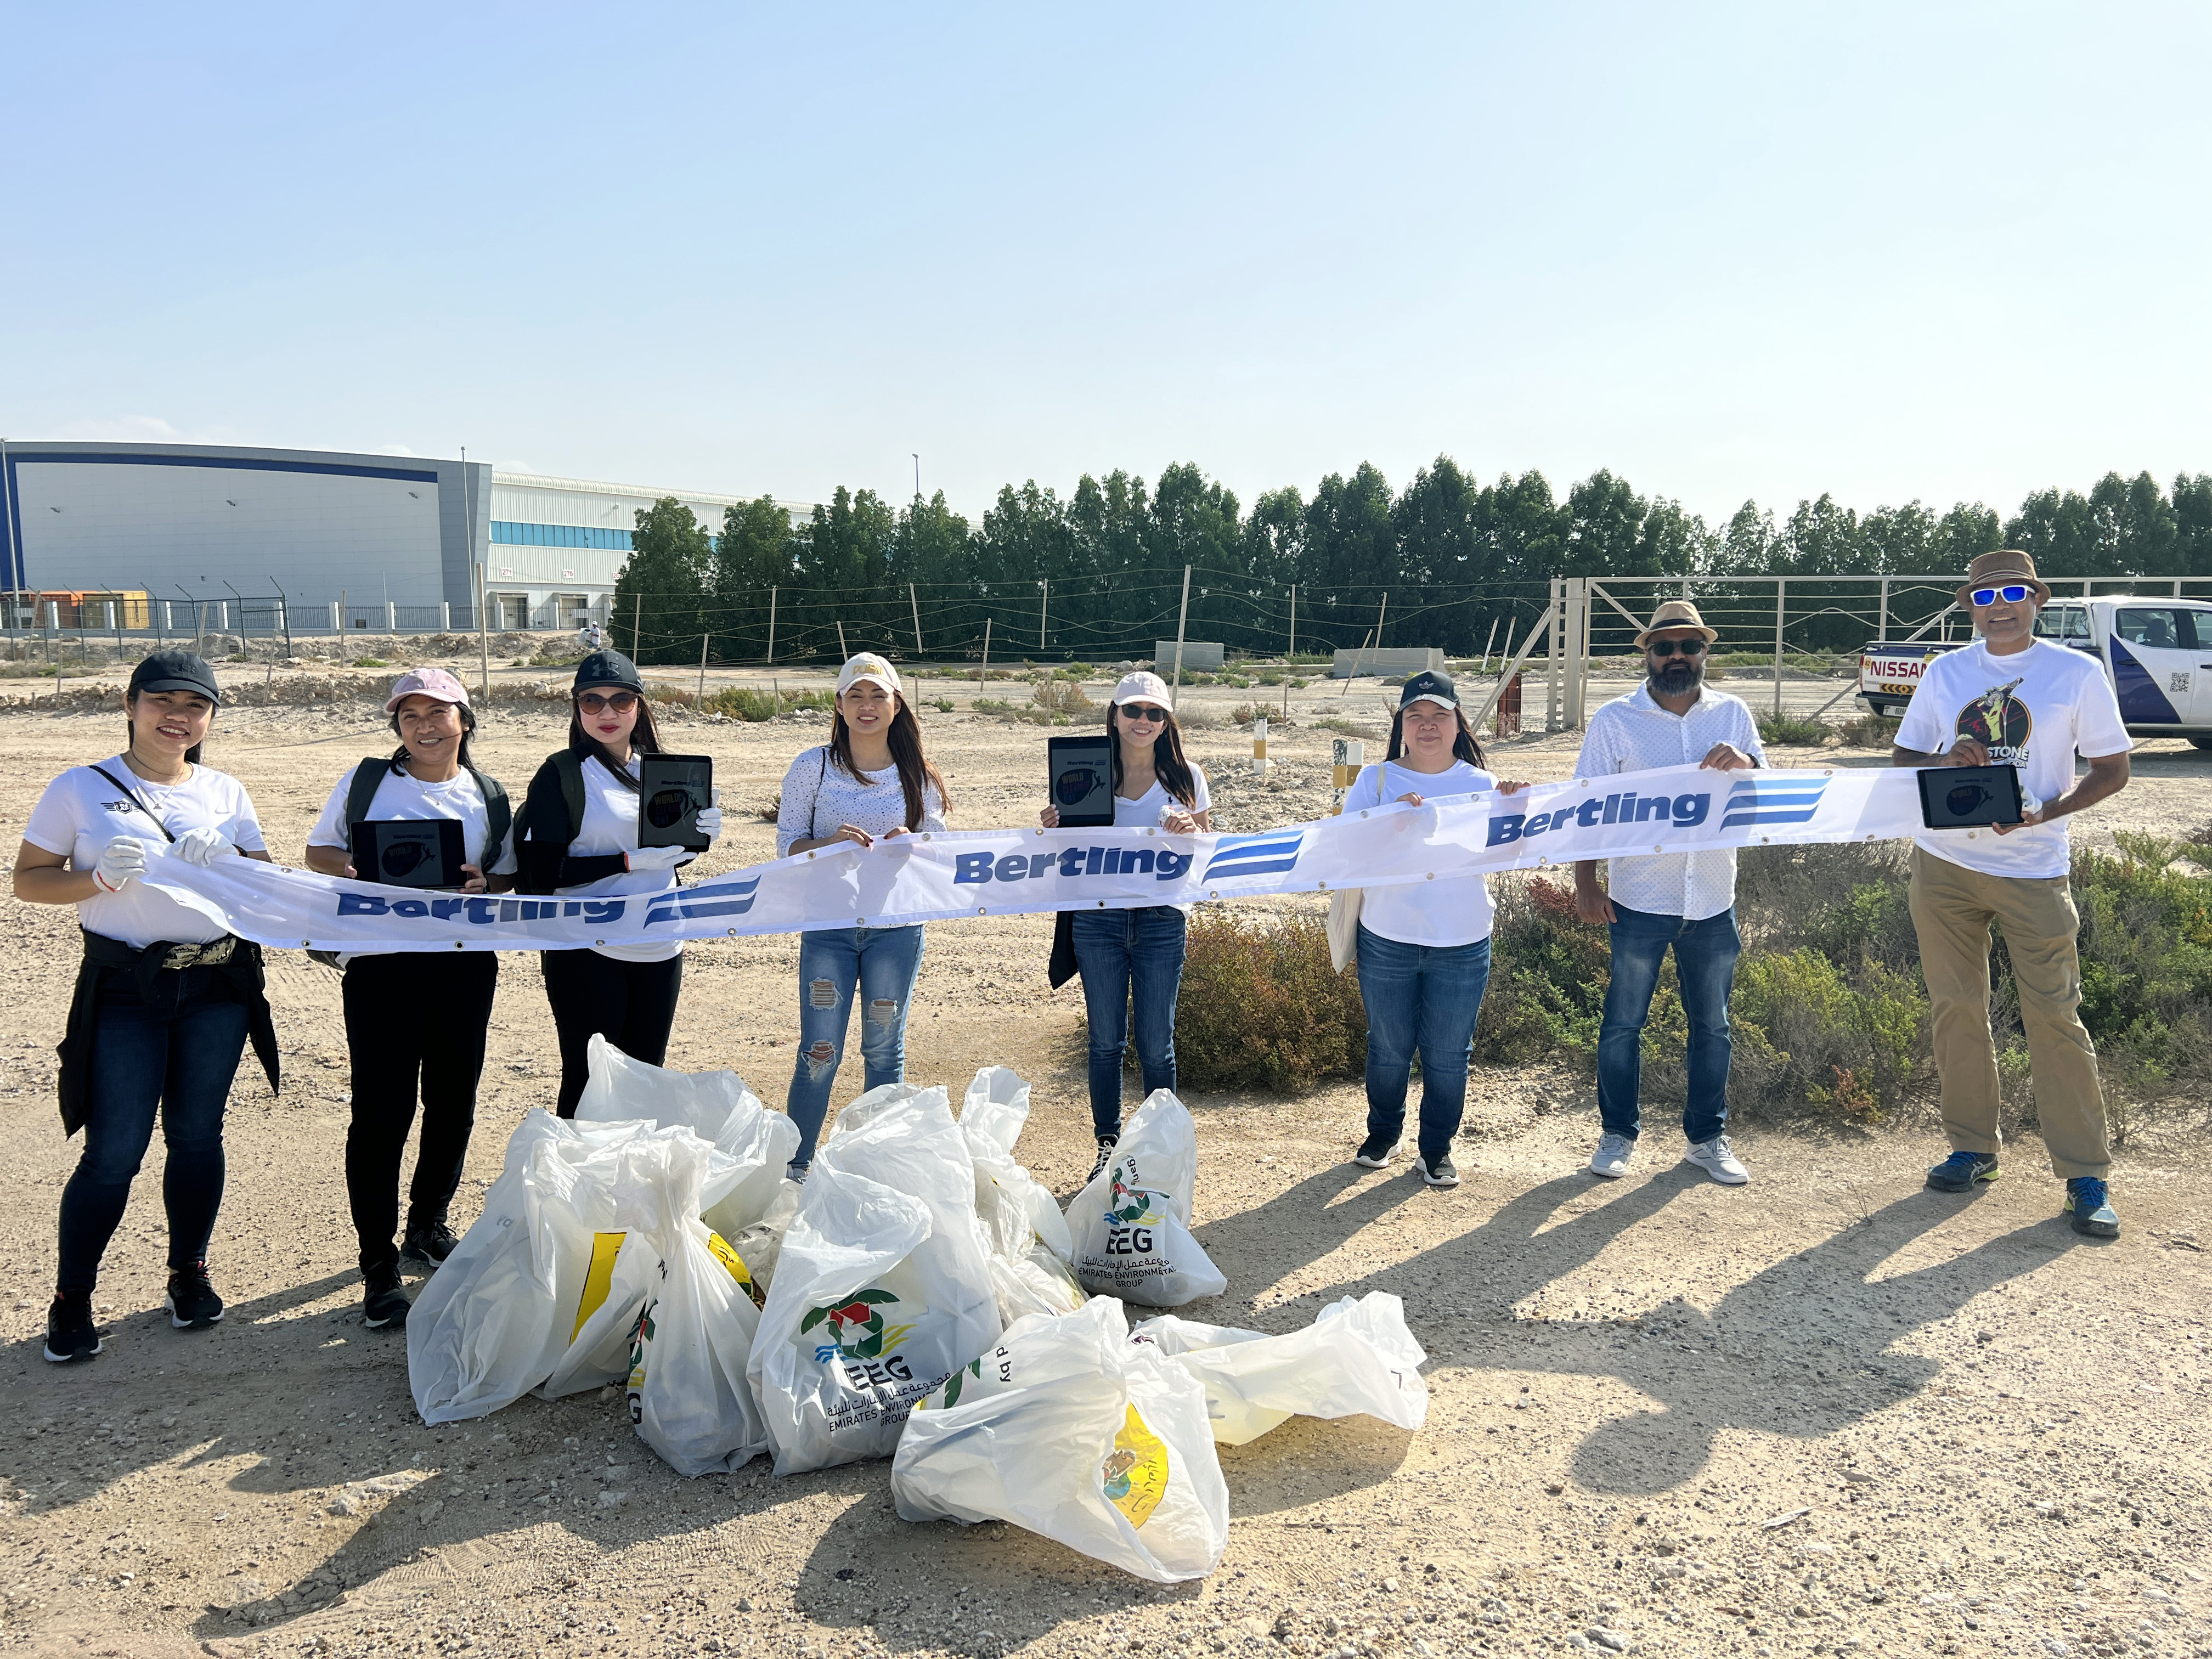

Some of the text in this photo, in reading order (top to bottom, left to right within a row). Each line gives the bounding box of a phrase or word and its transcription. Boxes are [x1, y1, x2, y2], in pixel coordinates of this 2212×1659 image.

[1485, 792, 1711, 847] Bertling
[953, 846, 1194, 884] Bertling
[337, 893, 625, 924] Bertling
[1105, 1227, 1153, 1255] EEG
[1078, 1267, 1113, 1279] EMIRATES
[1116, 1279, 1143, 1288] GROUP
[843, 1356, 913, 1391] EEG
[829, 1408, 878, 1432] EMIRATES
